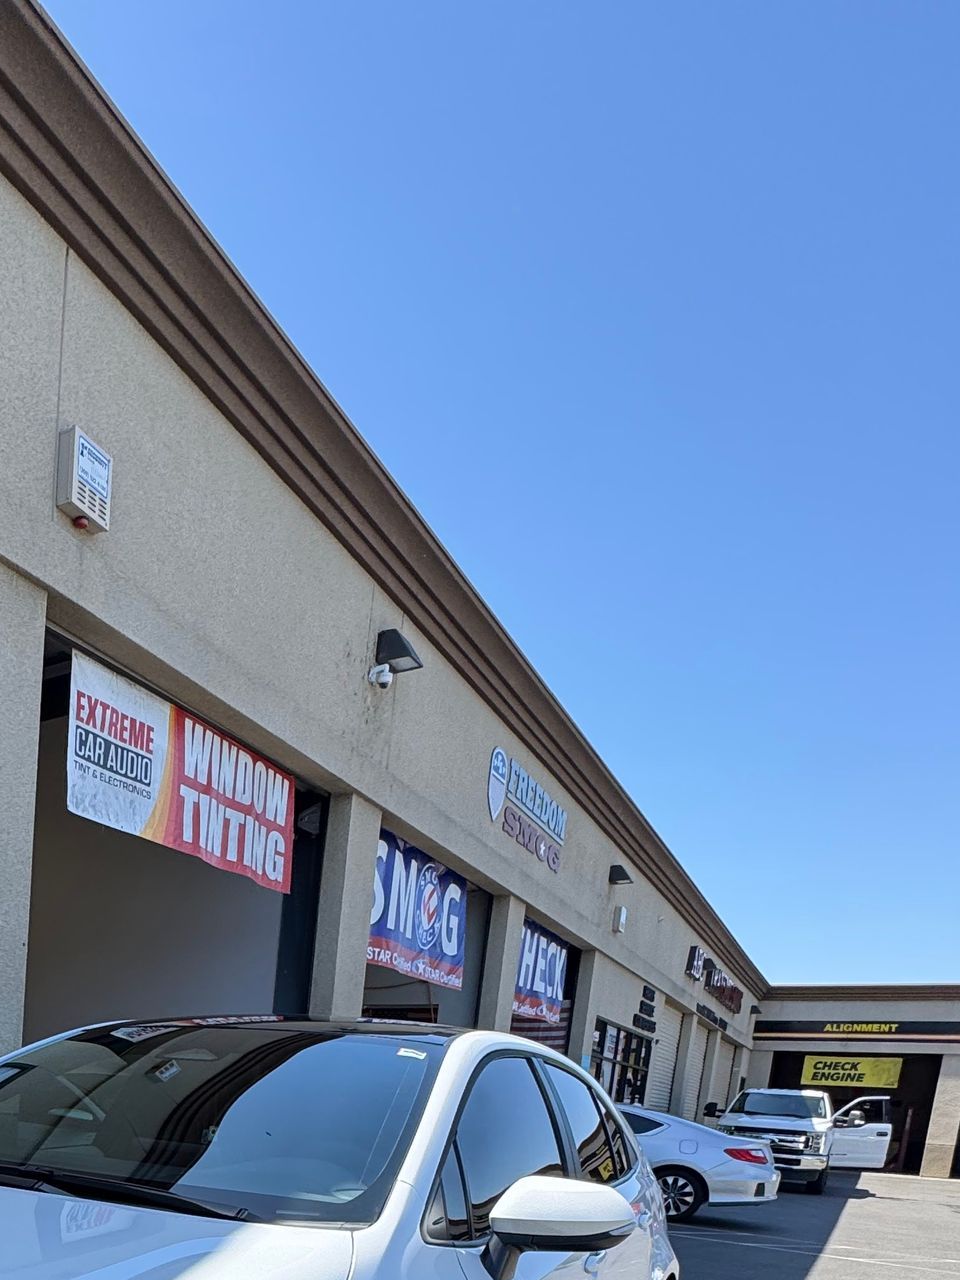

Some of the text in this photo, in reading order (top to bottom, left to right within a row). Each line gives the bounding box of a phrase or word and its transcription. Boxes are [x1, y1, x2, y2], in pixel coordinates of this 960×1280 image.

[76, 689, 154, 755] EXTREME
[74, 759, 152, 801] TINT & ELECTRONICS
[75, 728, 151, 784] CAR AUDIO
[184, 717, 291, 827] WINDOW
[507, 758, 568, 840] FREEDOM
[180, 783, 286, 883] TINTING
[502, 804, 561, 874] SMOG
[366, 946, 392, 965] STAR
[517, 926, 567, 1001] HECK
[824, 1023, 899, 1033] ALIGNMENT
[811, 1071, 866, 1083] ENGINE
[813, 1060, 861, 1072] CHECK
